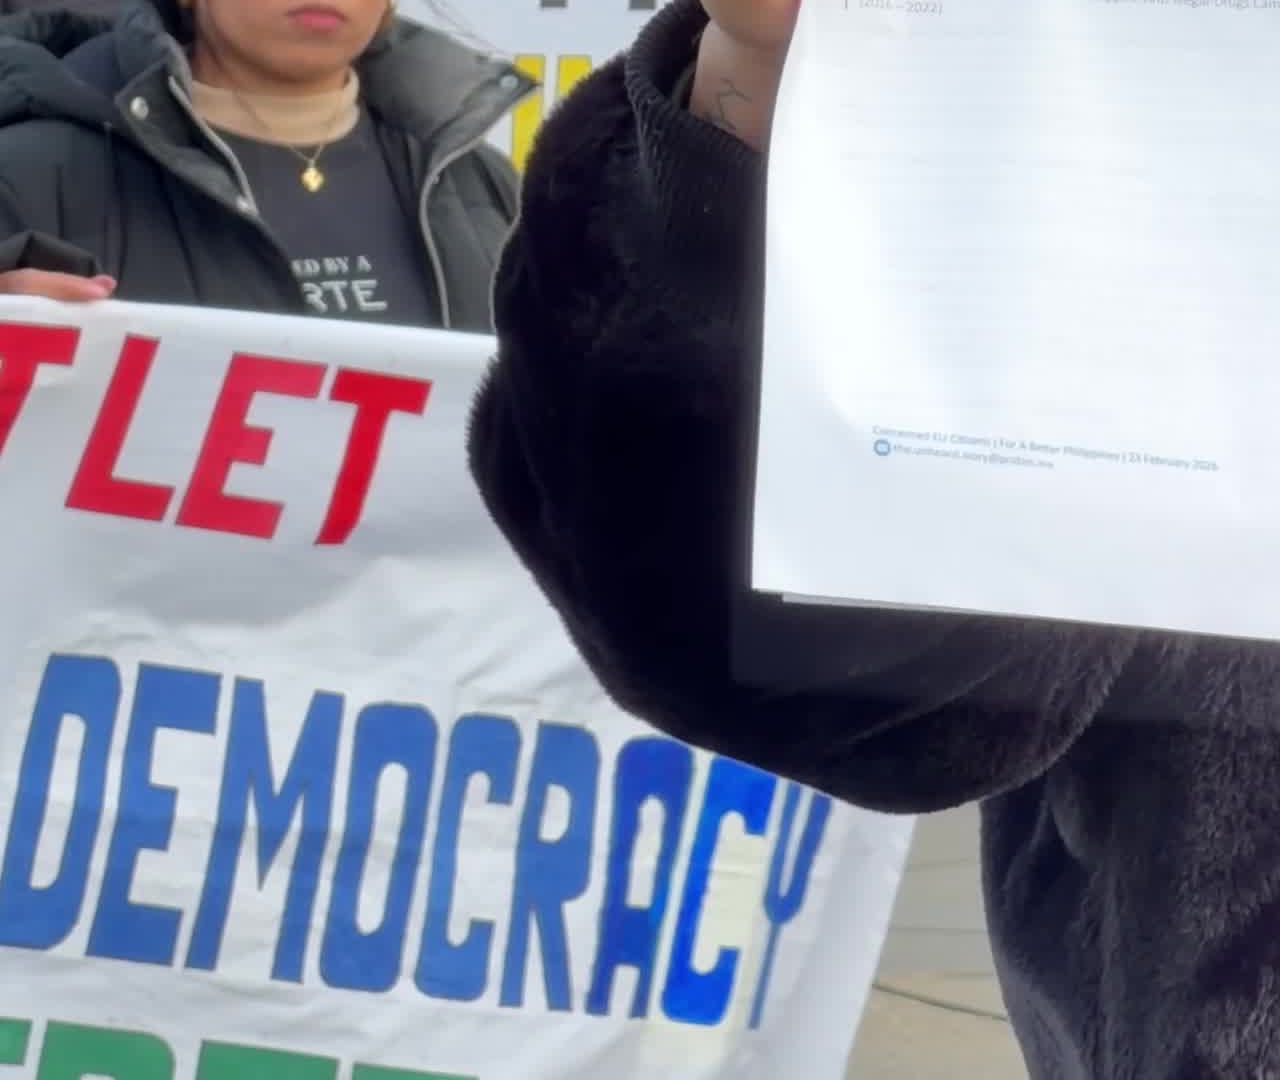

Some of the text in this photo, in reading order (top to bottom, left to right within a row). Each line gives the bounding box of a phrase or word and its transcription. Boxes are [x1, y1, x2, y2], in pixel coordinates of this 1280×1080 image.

[323, 257, 350, 274] BY
[356, 255, 373, 272] A
[65, 333, 433, 547] LET
[0, 652, 832, 1030] DEMOCRACY
